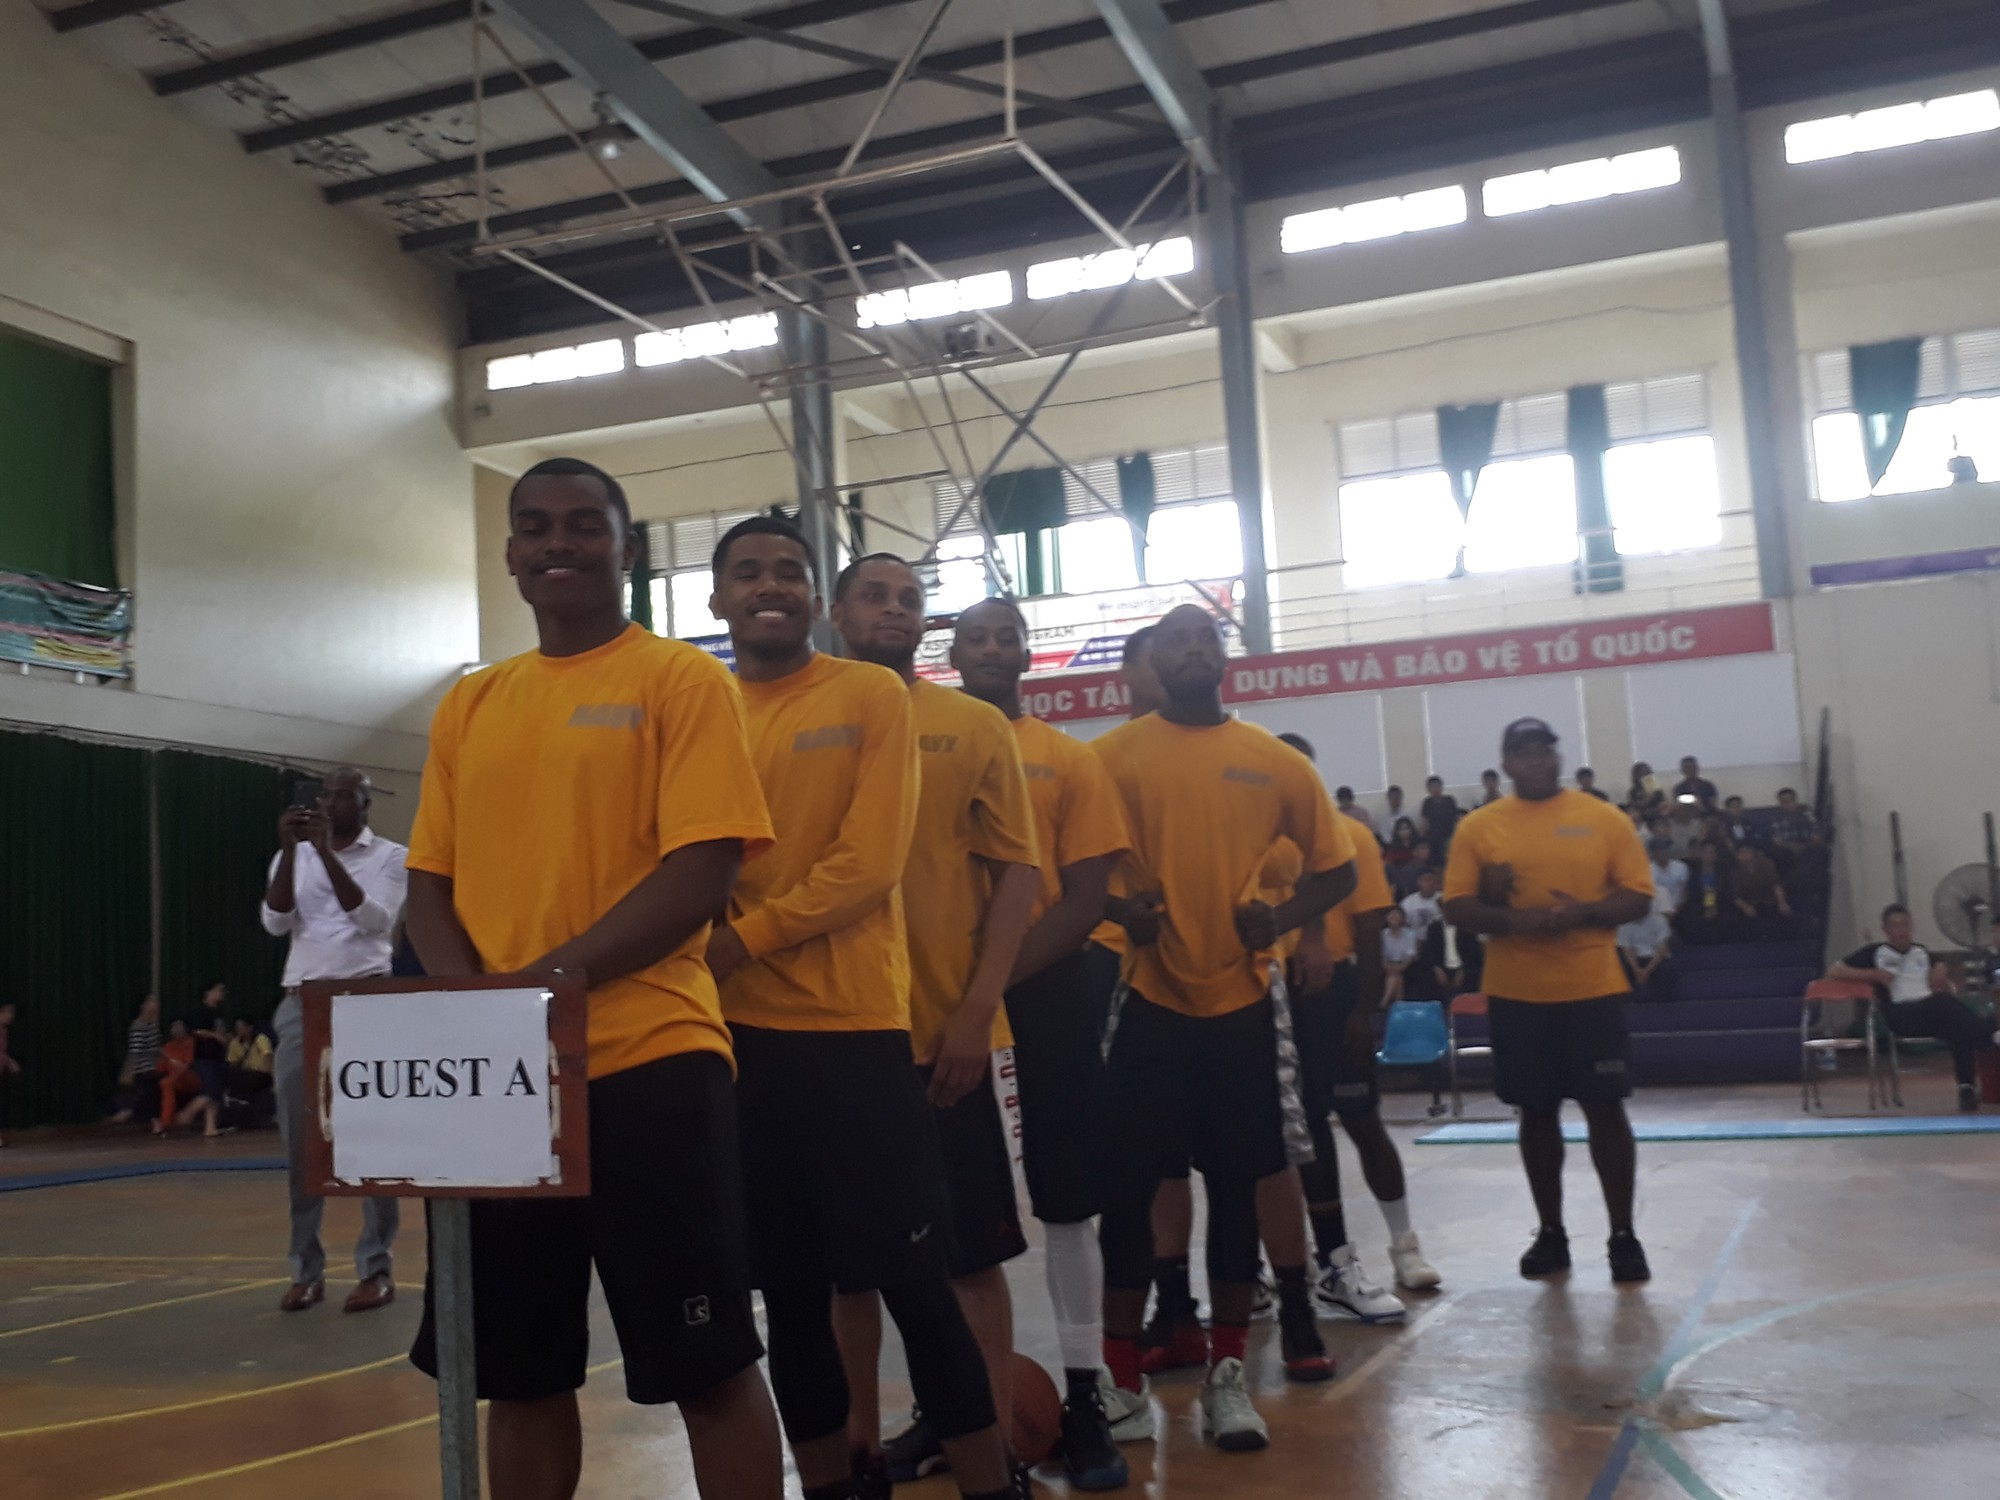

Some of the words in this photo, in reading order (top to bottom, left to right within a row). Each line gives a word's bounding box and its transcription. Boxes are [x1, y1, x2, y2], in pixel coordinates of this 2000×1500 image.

[1233, 663, 1329, 695] DỰNG
[1337, 652, 1384, 683] VÀ
[1477, 639, 1522, 673] VỆ
[1590, 620, 1697, 661] QUỐC
[339, 1057, 490, 1099] GUEST
[504, 1056, 538, 1096] A
